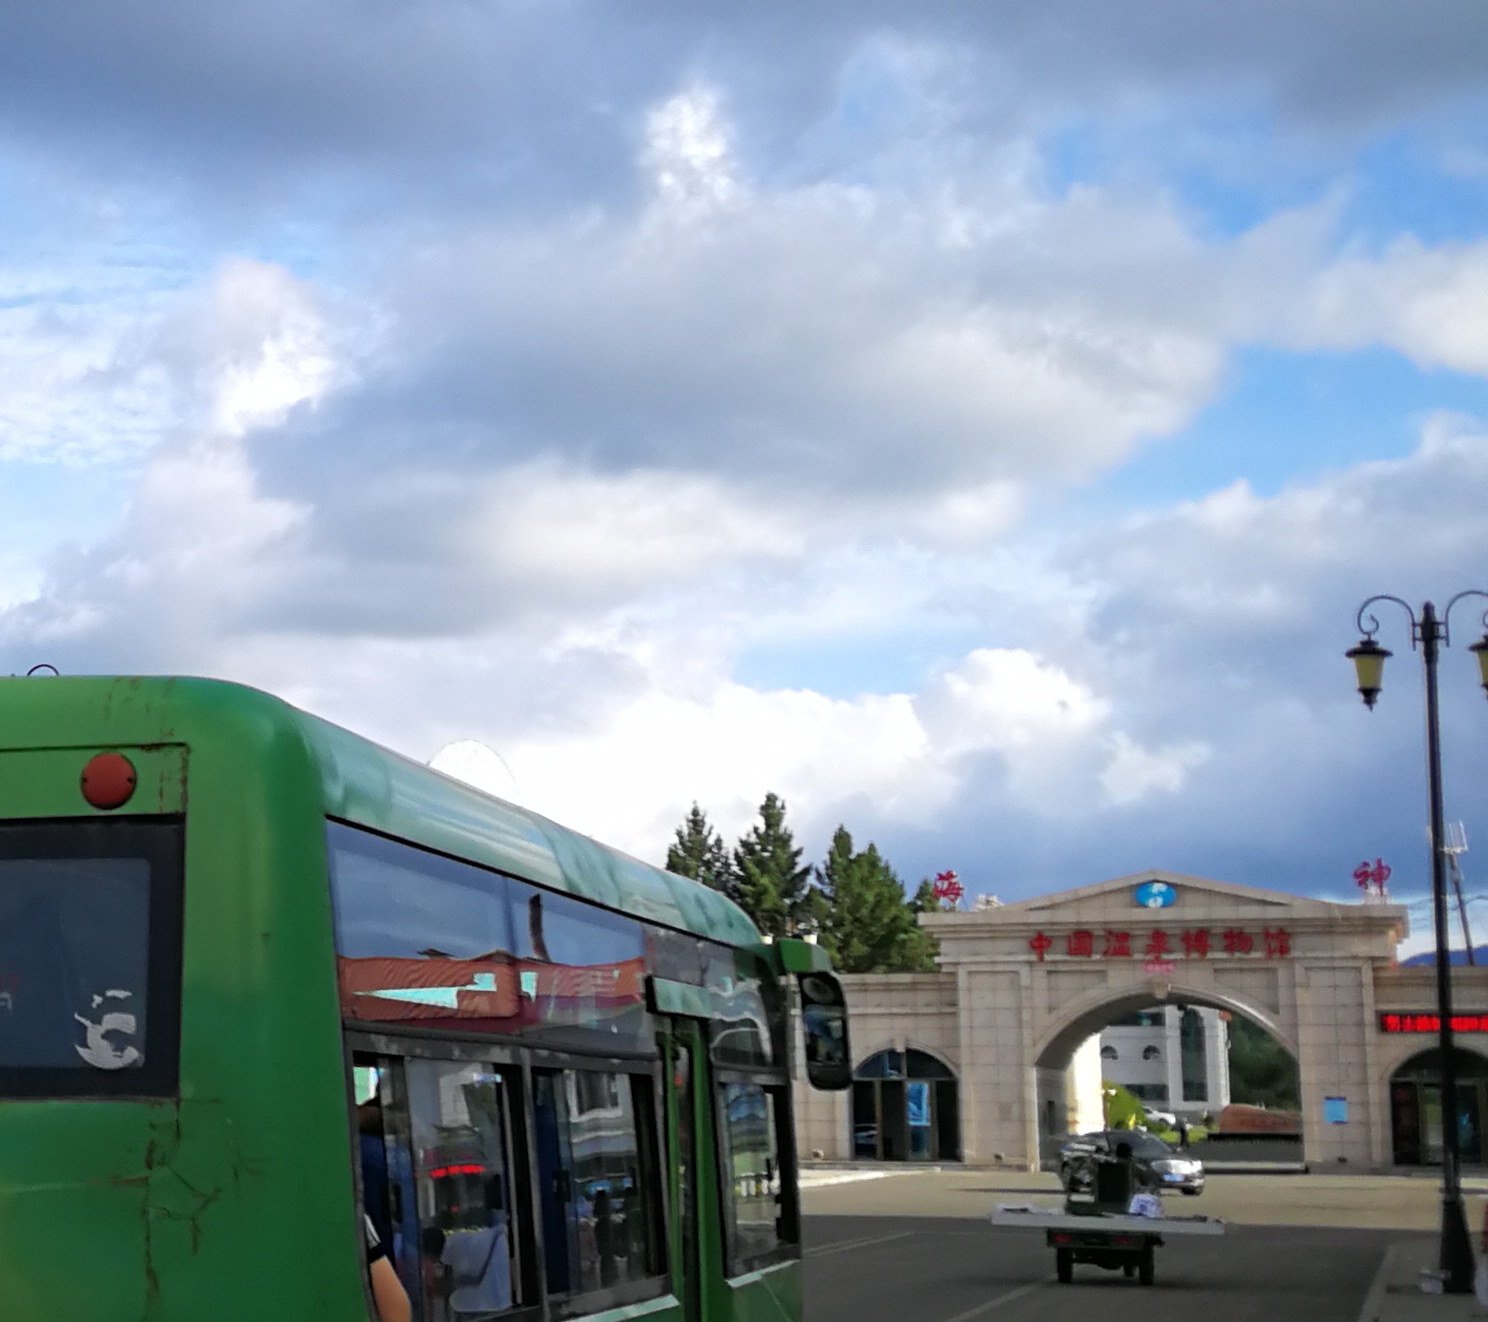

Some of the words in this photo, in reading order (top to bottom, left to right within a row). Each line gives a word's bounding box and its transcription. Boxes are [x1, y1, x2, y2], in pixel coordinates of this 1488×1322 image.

[1029, 927, 1291, 962] 中国温泉博物馆
